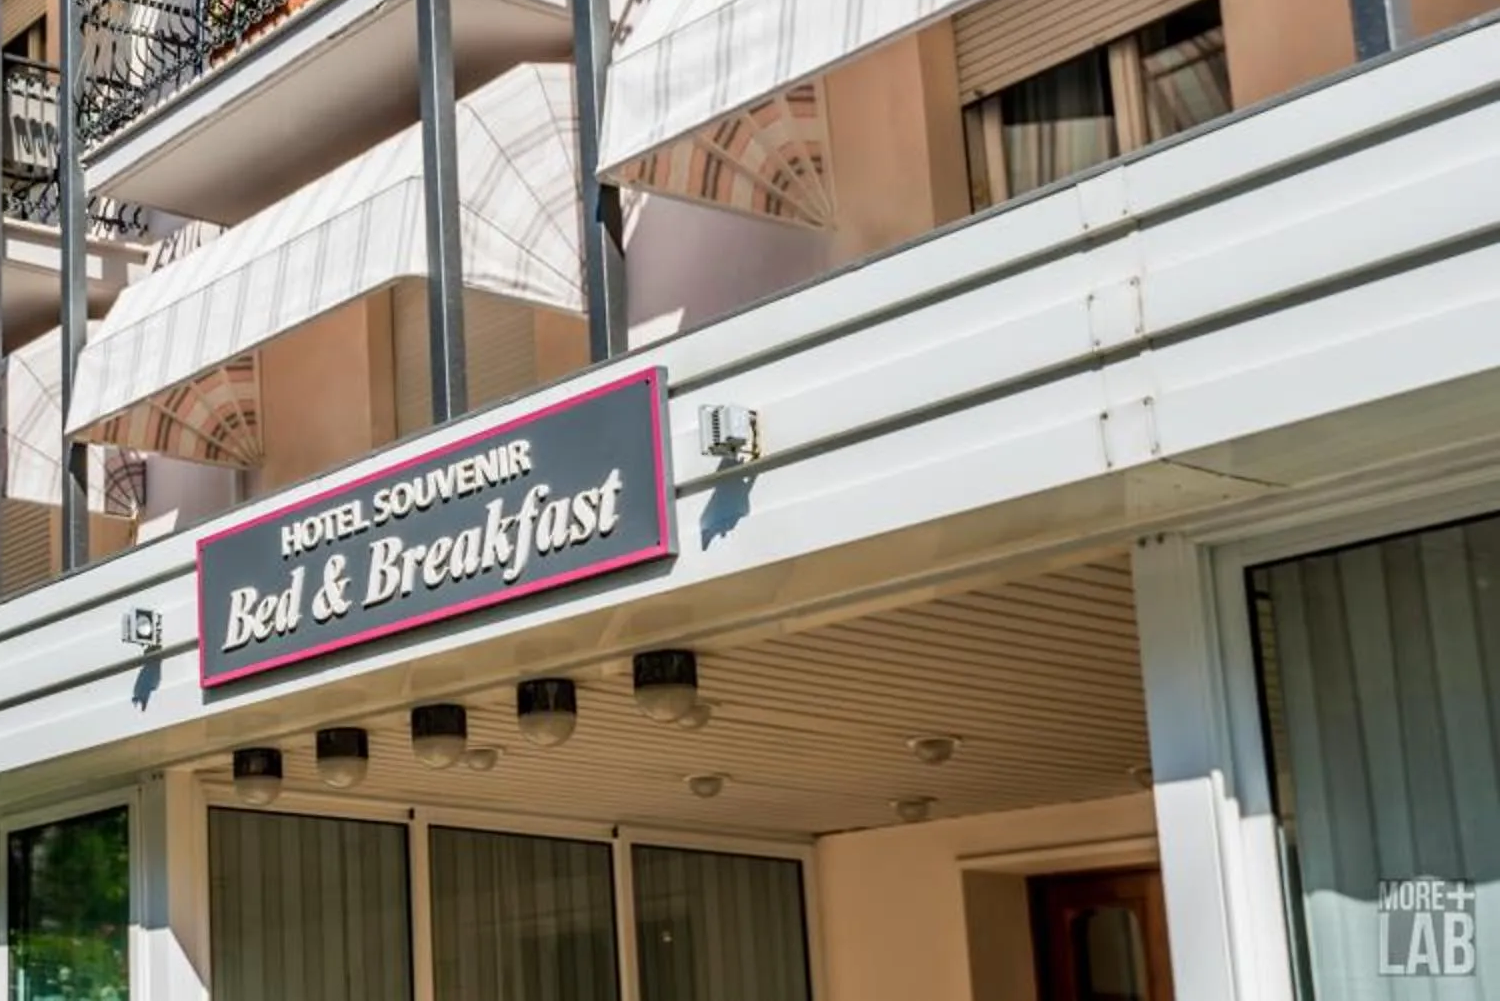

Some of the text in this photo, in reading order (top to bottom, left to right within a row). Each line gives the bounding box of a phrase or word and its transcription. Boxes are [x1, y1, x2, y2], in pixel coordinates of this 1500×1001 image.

[222, 468, 623, 652] Bed & Breakfast
[281, 439, 532, 557] HOTEL SOUVENIR
